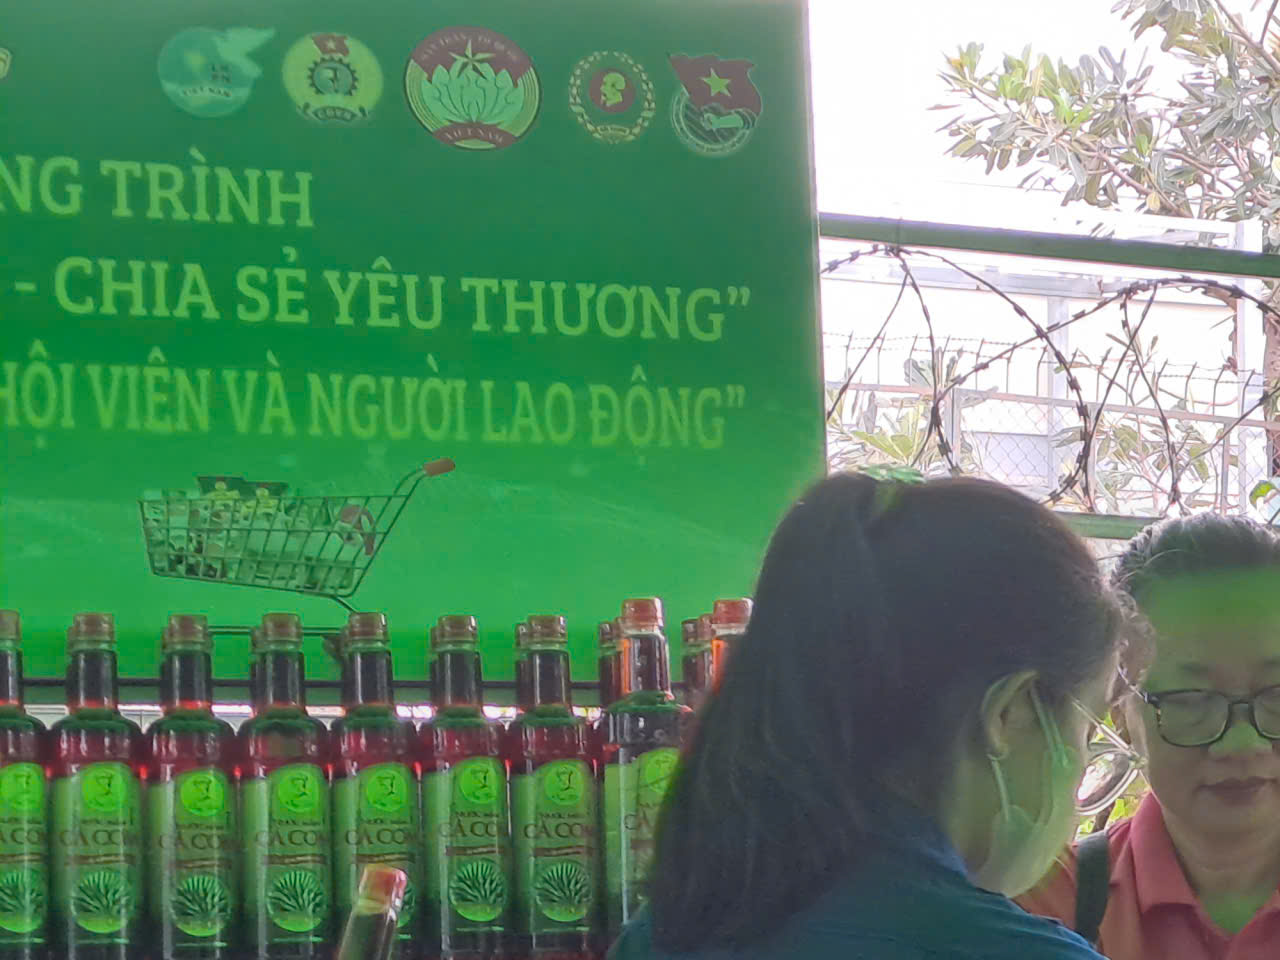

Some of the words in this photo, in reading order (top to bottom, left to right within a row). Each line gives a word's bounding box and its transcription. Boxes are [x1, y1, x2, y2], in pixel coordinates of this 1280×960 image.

[100, 146, 314, 228] TRÌNH
[54, 256, 221, 320] CHIA
[235, 246, 310, 324] SẺ
[322, 255, 446, 330] YÊU
[85, 345, 211, 433] VIÊN
[221, 348, 297, 437] VÀ
[307, 352, 469, 442] NGƯỜI
[480, 379, 577, 446] LAO
